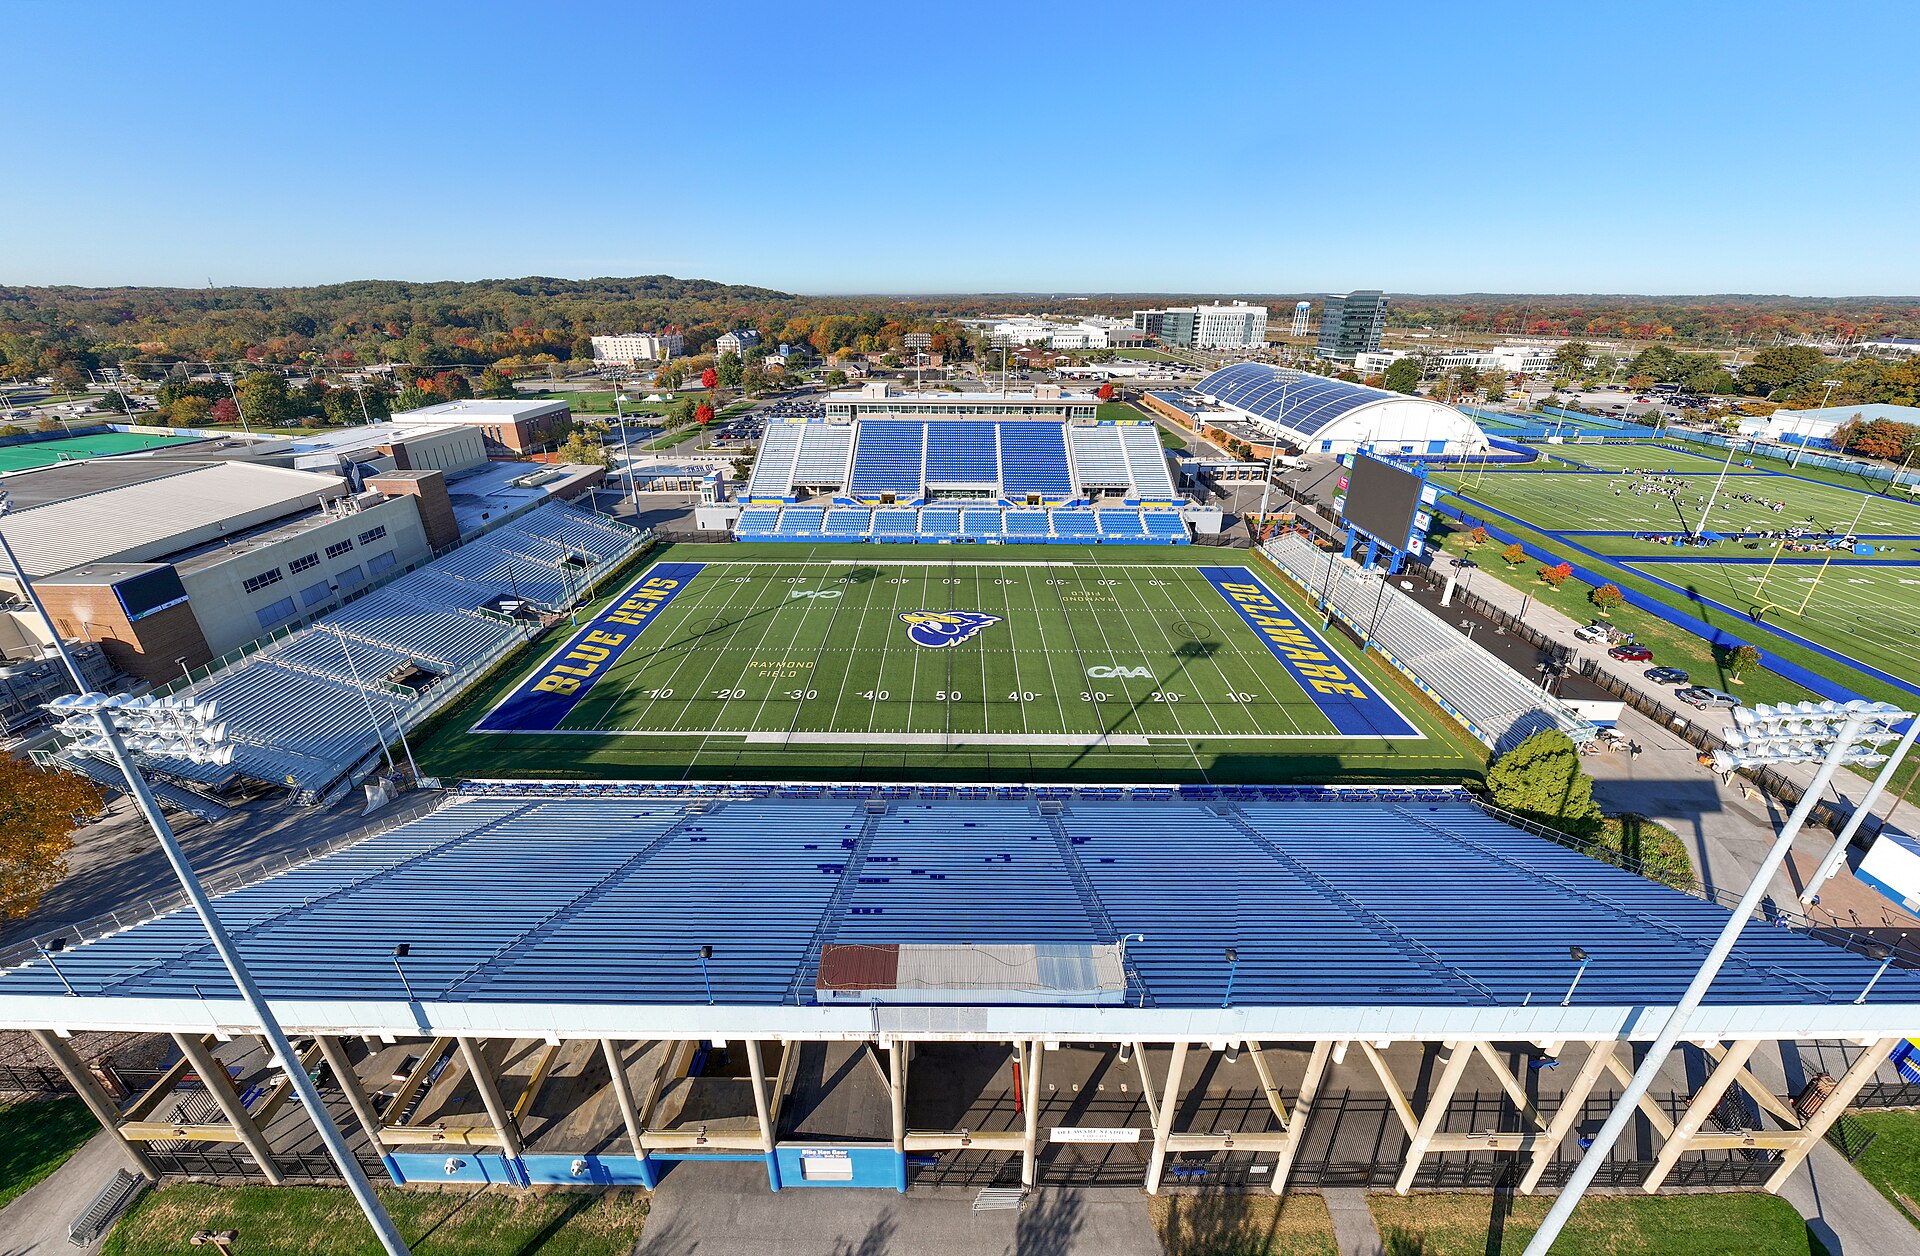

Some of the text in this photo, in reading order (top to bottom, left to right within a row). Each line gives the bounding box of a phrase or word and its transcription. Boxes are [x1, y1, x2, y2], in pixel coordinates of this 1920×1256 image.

[1365, 451, 1413, 473] DELAWARE STADIUM
[791, 590, 842, 599] CAA
[531, 577, 679, 696] BLUE HENS
[1219, 581, 1369, 700] DELAWARE
[758, 670, 797, 678] FIELD
[1087, 665, 1153, 678] CAA
[650, 688, 674, 699] 10
[716, 689, 746, 699] 20
[790, 689, 818, 700] 30
[862, 690, 890, 701] 40
[935, 690, 962, 701] 50
[1007, 691, 1035, 702] 40
[1080, 692, 1107, 702] 30
[1151, 692, 1179, 703] 20
[1226, 692, 1252, 703] 10
